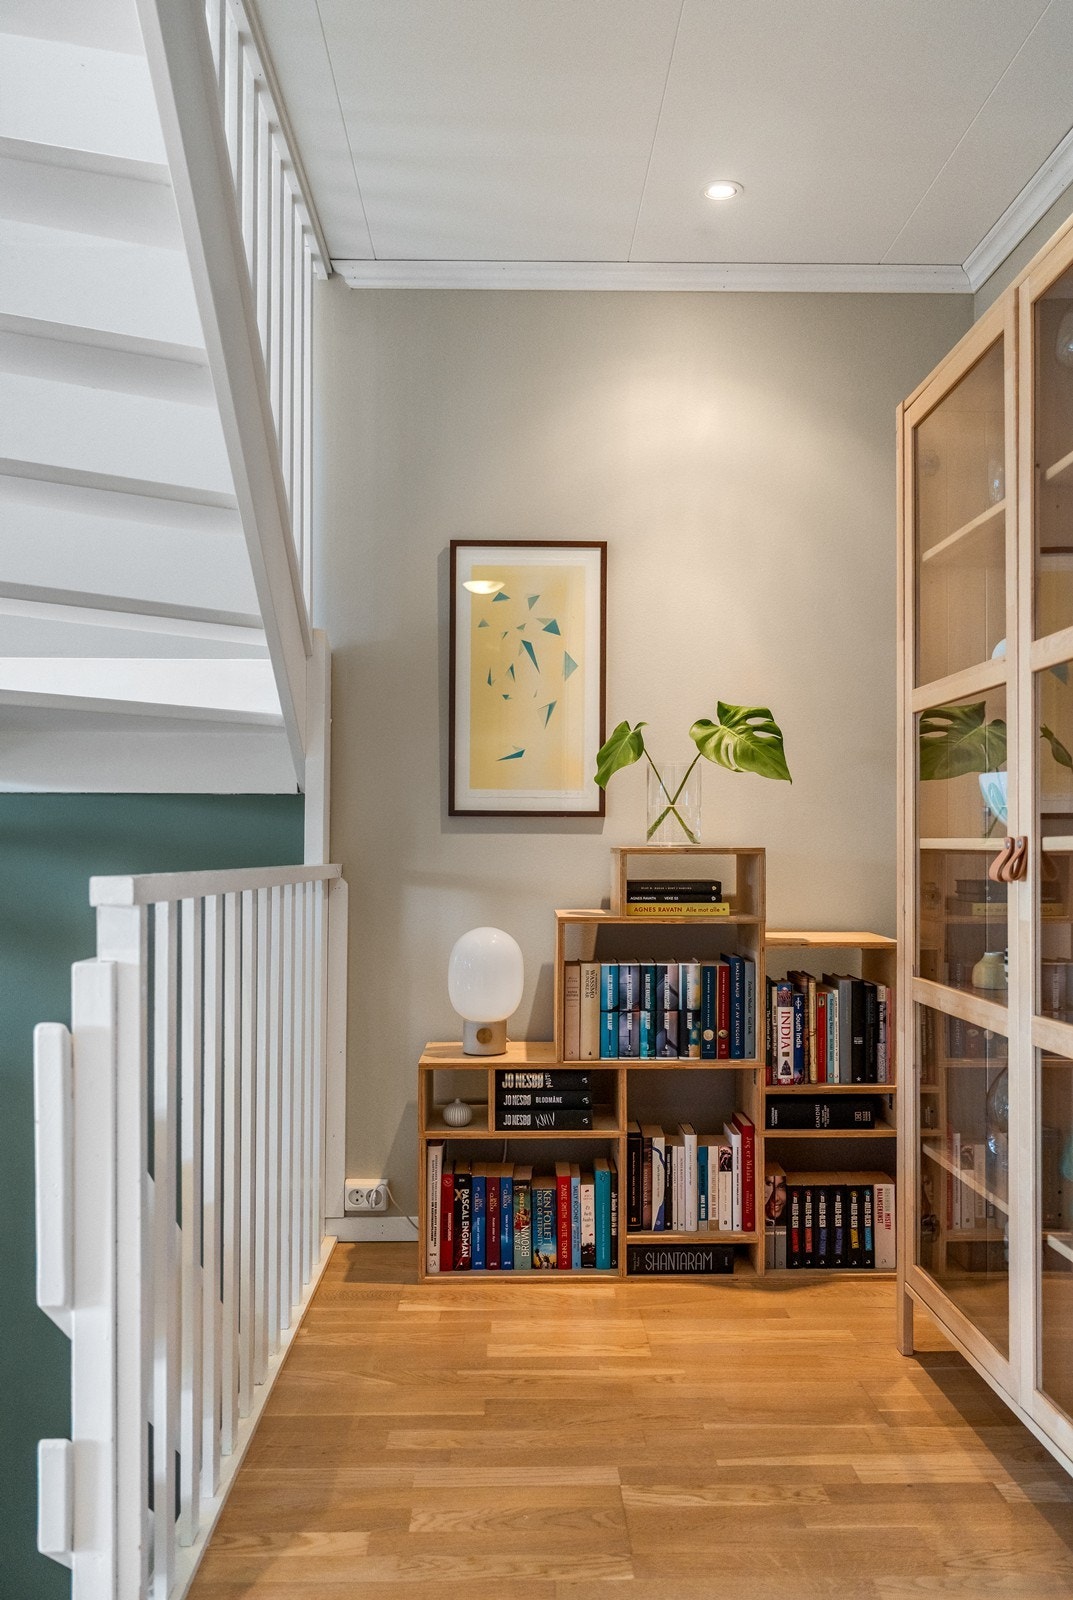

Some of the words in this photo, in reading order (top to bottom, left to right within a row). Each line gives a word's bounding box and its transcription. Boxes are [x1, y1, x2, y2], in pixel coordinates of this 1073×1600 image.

[735, 1002, 740, 1010] UT
[781, 1011, 791, 1050] INDIA
[502, 1073, 514, 1089] JO
[515, 1072, 544, 1089] NESBØ
[503, 1095, 512, 1106] JO
[512, 1094, 532, 1106] NESBØ
[535, 1096, 563, 1104] BLODMÅNE
[503, 1114, 512, 1126] JO
[512, 1114, 532, 1126] NESBØ
[535, 1112, 556, 1129] KNIV
[744, 1136, 753, 1149] Jeg
[746, 1150, 751, 1158] er
[461, 1189, 470, 1220] PASCAL
[543, 1190, 552, 1208] KEN
[537, 1207, 543, 1215] OF
[792, 1203, 800, 1229] ADLER-OLSEN
[805, 1202, 813, 1228] ADLER-OLSEN
[819, 1202, 827, 1228] ADLER-OLSEN
[850, 1203, 858, 1229] ADLER-OLSEN
[864, 1202, 872, 1228] ADLER-OLSEN
[884, 1212, 892, 1231] MISTRY
[461, 1221, 470, 1258] ENGMAN
[521, 1225, 530, 1257] BROWN
[543, 1210, 553, 1251] FOLLETT
[645, 1252, 714, 1271] SHANTARAM
